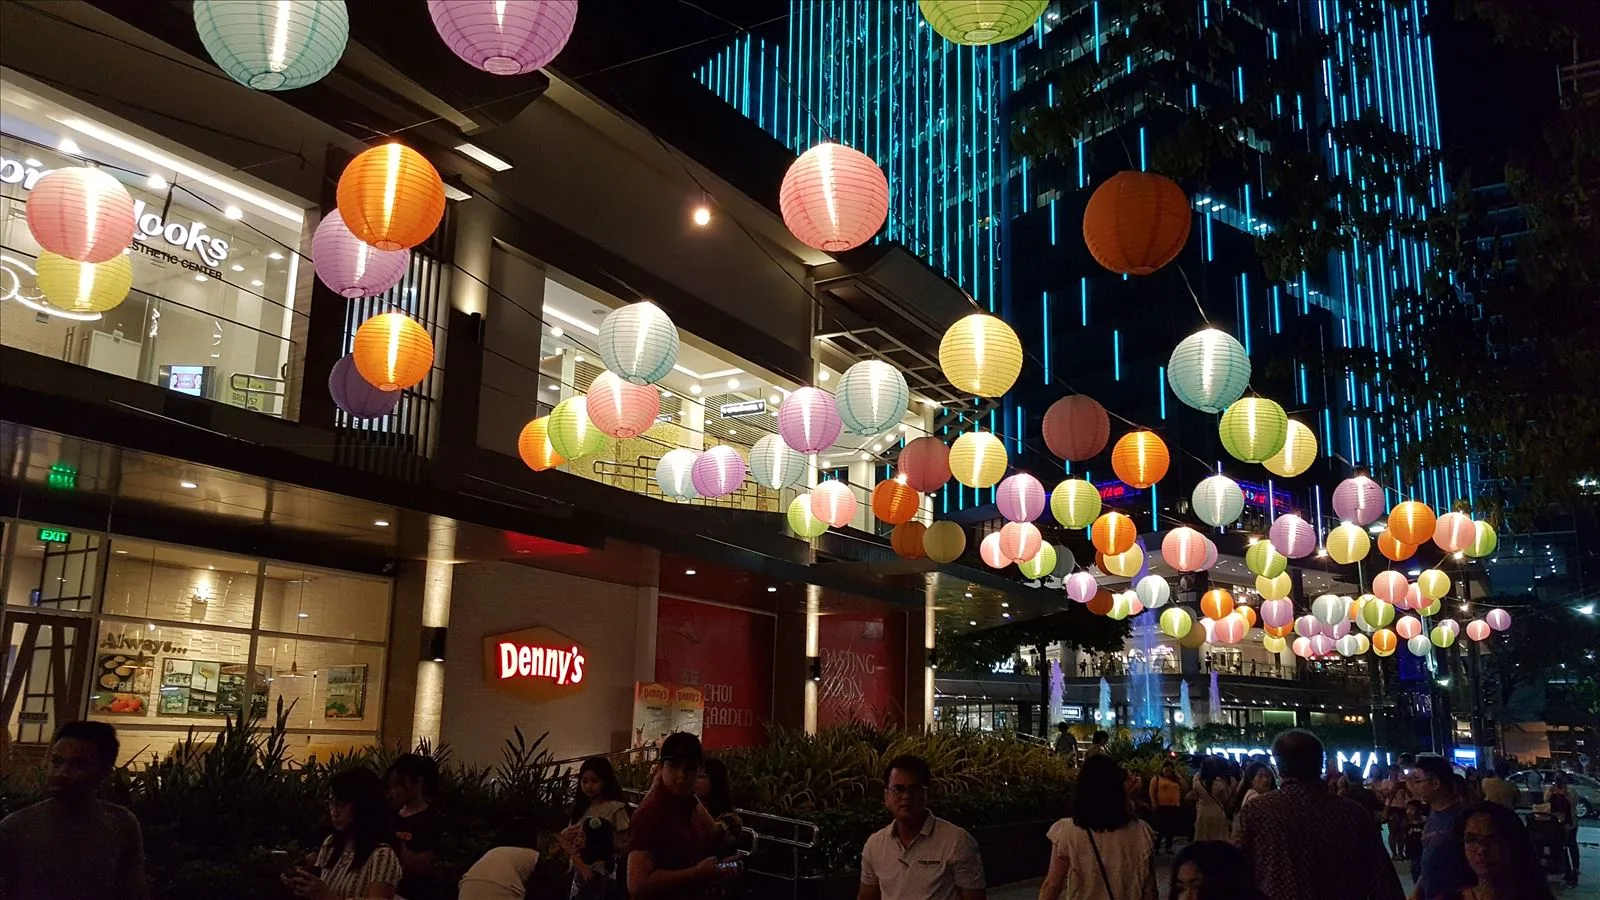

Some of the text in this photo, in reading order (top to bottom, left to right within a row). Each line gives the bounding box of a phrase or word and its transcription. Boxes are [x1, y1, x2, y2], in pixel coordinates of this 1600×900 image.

[129, 240, 223, 280] STHETIC CENTER
[40, 530, 68, 542] EXIT
[500, 642, 585, 685] Denny's
[250, 694, 268, 703] PEN
[704, 683, 734, 703] CHOI
[703, 706, 754, 727] GARDEN
